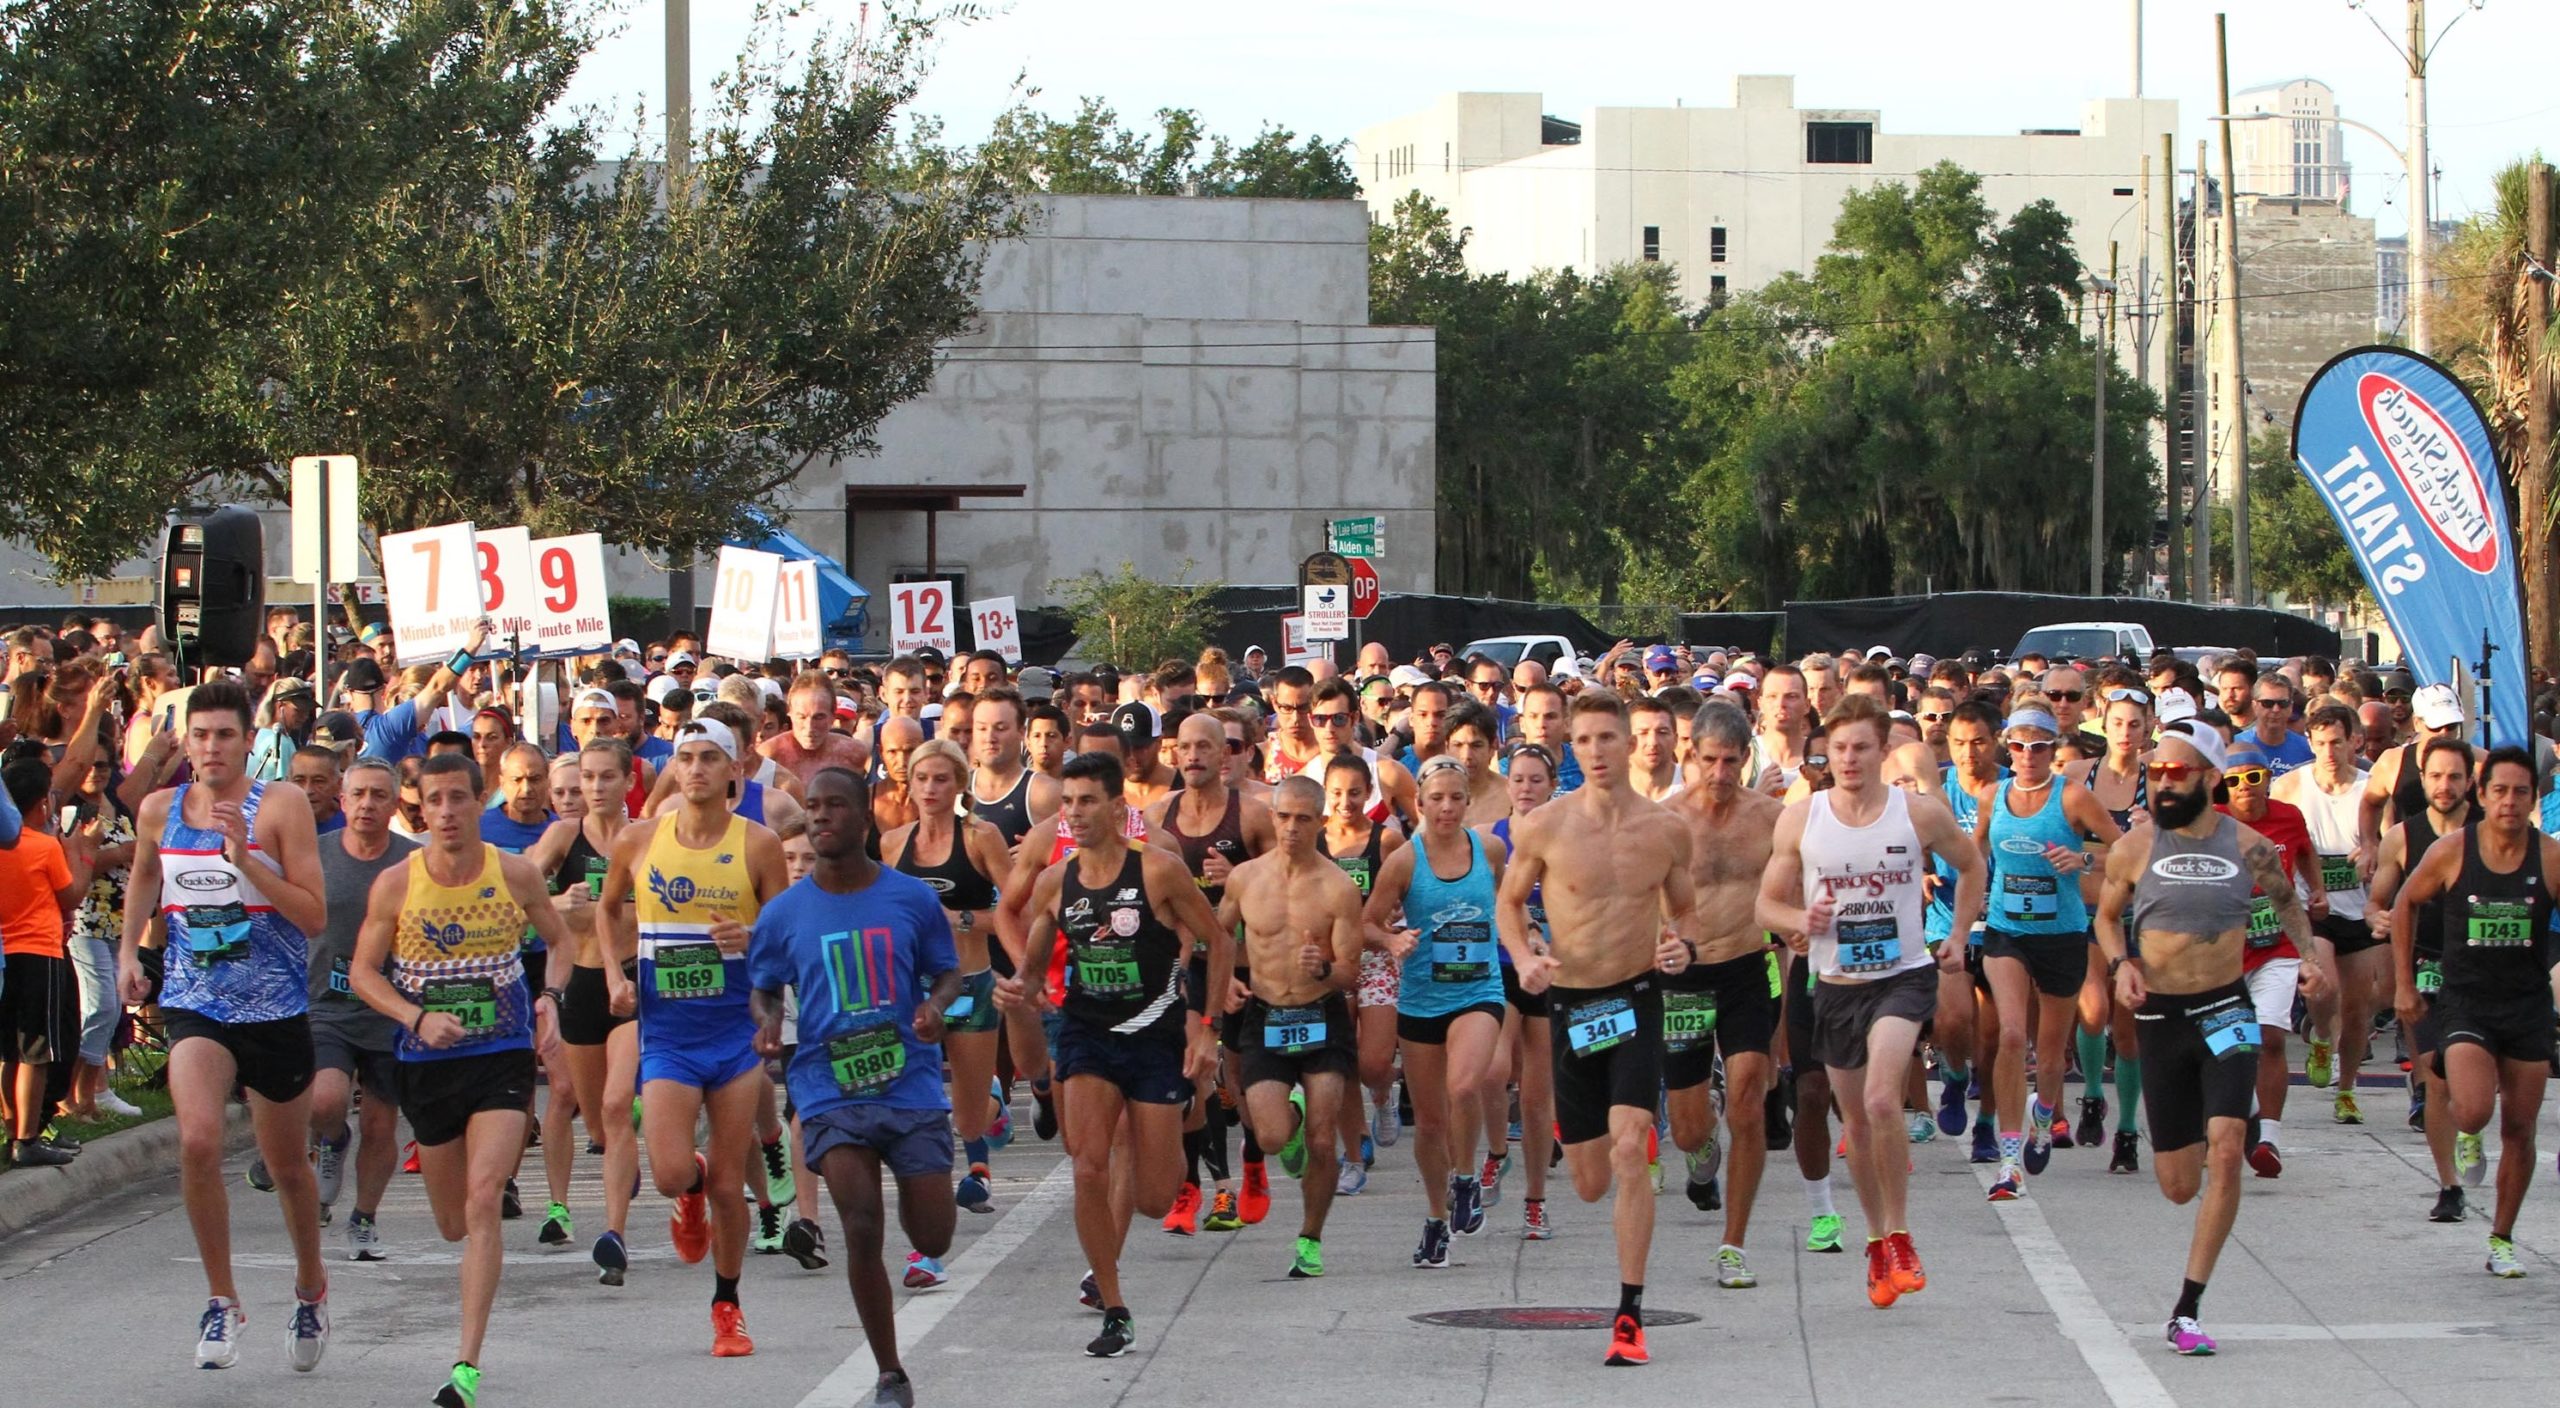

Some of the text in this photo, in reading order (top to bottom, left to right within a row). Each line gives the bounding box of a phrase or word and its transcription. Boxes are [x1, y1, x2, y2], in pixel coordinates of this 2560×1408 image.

[1338, 540, 1375, 554] Alden Rd
[411, 538, 442, 613] 7
[539, 547, 578, 614] 9
[723, 567, 754, 613] 10
[779, 568, 807, 623] 11
[1354, 576, 1377, 600] OP
[897, 587, 944, 635] 12
[1308, 610, 1346, 619] STROLLERS
[400, 619, 446, 643] Minute
[502, 616, 532, 634] Mile
[538, 617, 604, 639] inute Mile
[977, 610, 1014, 641] 13+
[931, 638, 951, 649] Mile
[2160, 860, 2232, 874] Track Shack
[2322, 871, 2352, 884] 1550
[670, 879, 692, 900] fit
[1846, 900, 1895, 916] BROOKS
[2023, 897, 2032, 912] 5
[214, 930, 224, 946] 1
[444, 925, 462, 943] fit
[2479, 922, 2521, 939] 1243
[1456, 945, 1467, 962] 3
[1851, 943, 1886, 962] 545
[666, 968, 713, 990] 1869
[1086, 966, 1129, 983] 1705
[1584, 1018, 1618, 1043] 341
[1665, 1013, 1707, 1032] 1023
[1280, 1026, 1310, 1045] 318
[2232, 1026, 2247, 1042] 8
[843, 1050, 896, 1081] 1880
